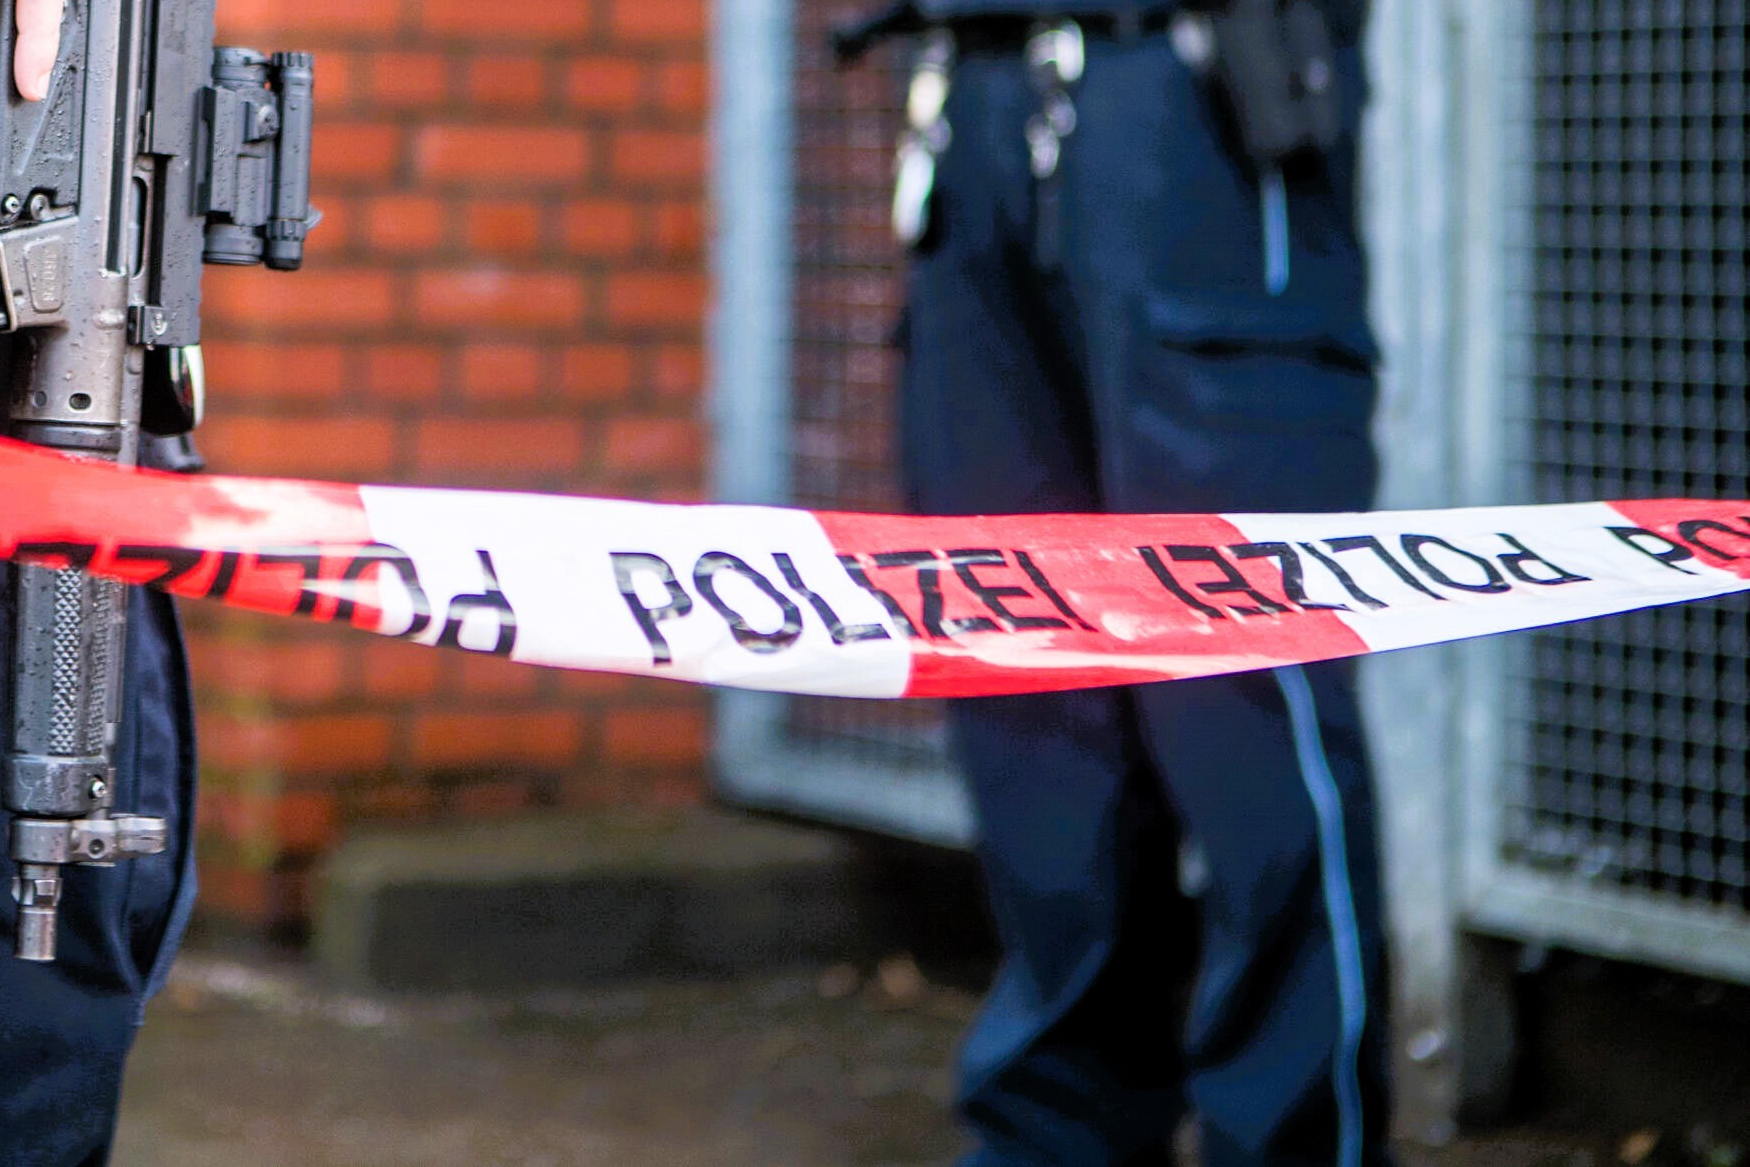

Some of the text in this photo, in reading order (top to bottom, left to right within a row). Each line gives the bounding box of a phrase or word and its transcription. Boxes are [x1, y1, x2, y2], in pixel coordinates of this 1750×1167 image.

[1135, 533, 1594, 619] POLIZEI
[1601, 515, 1750, 576] PO
[608, 549, 1099, 667] POLIZEI
